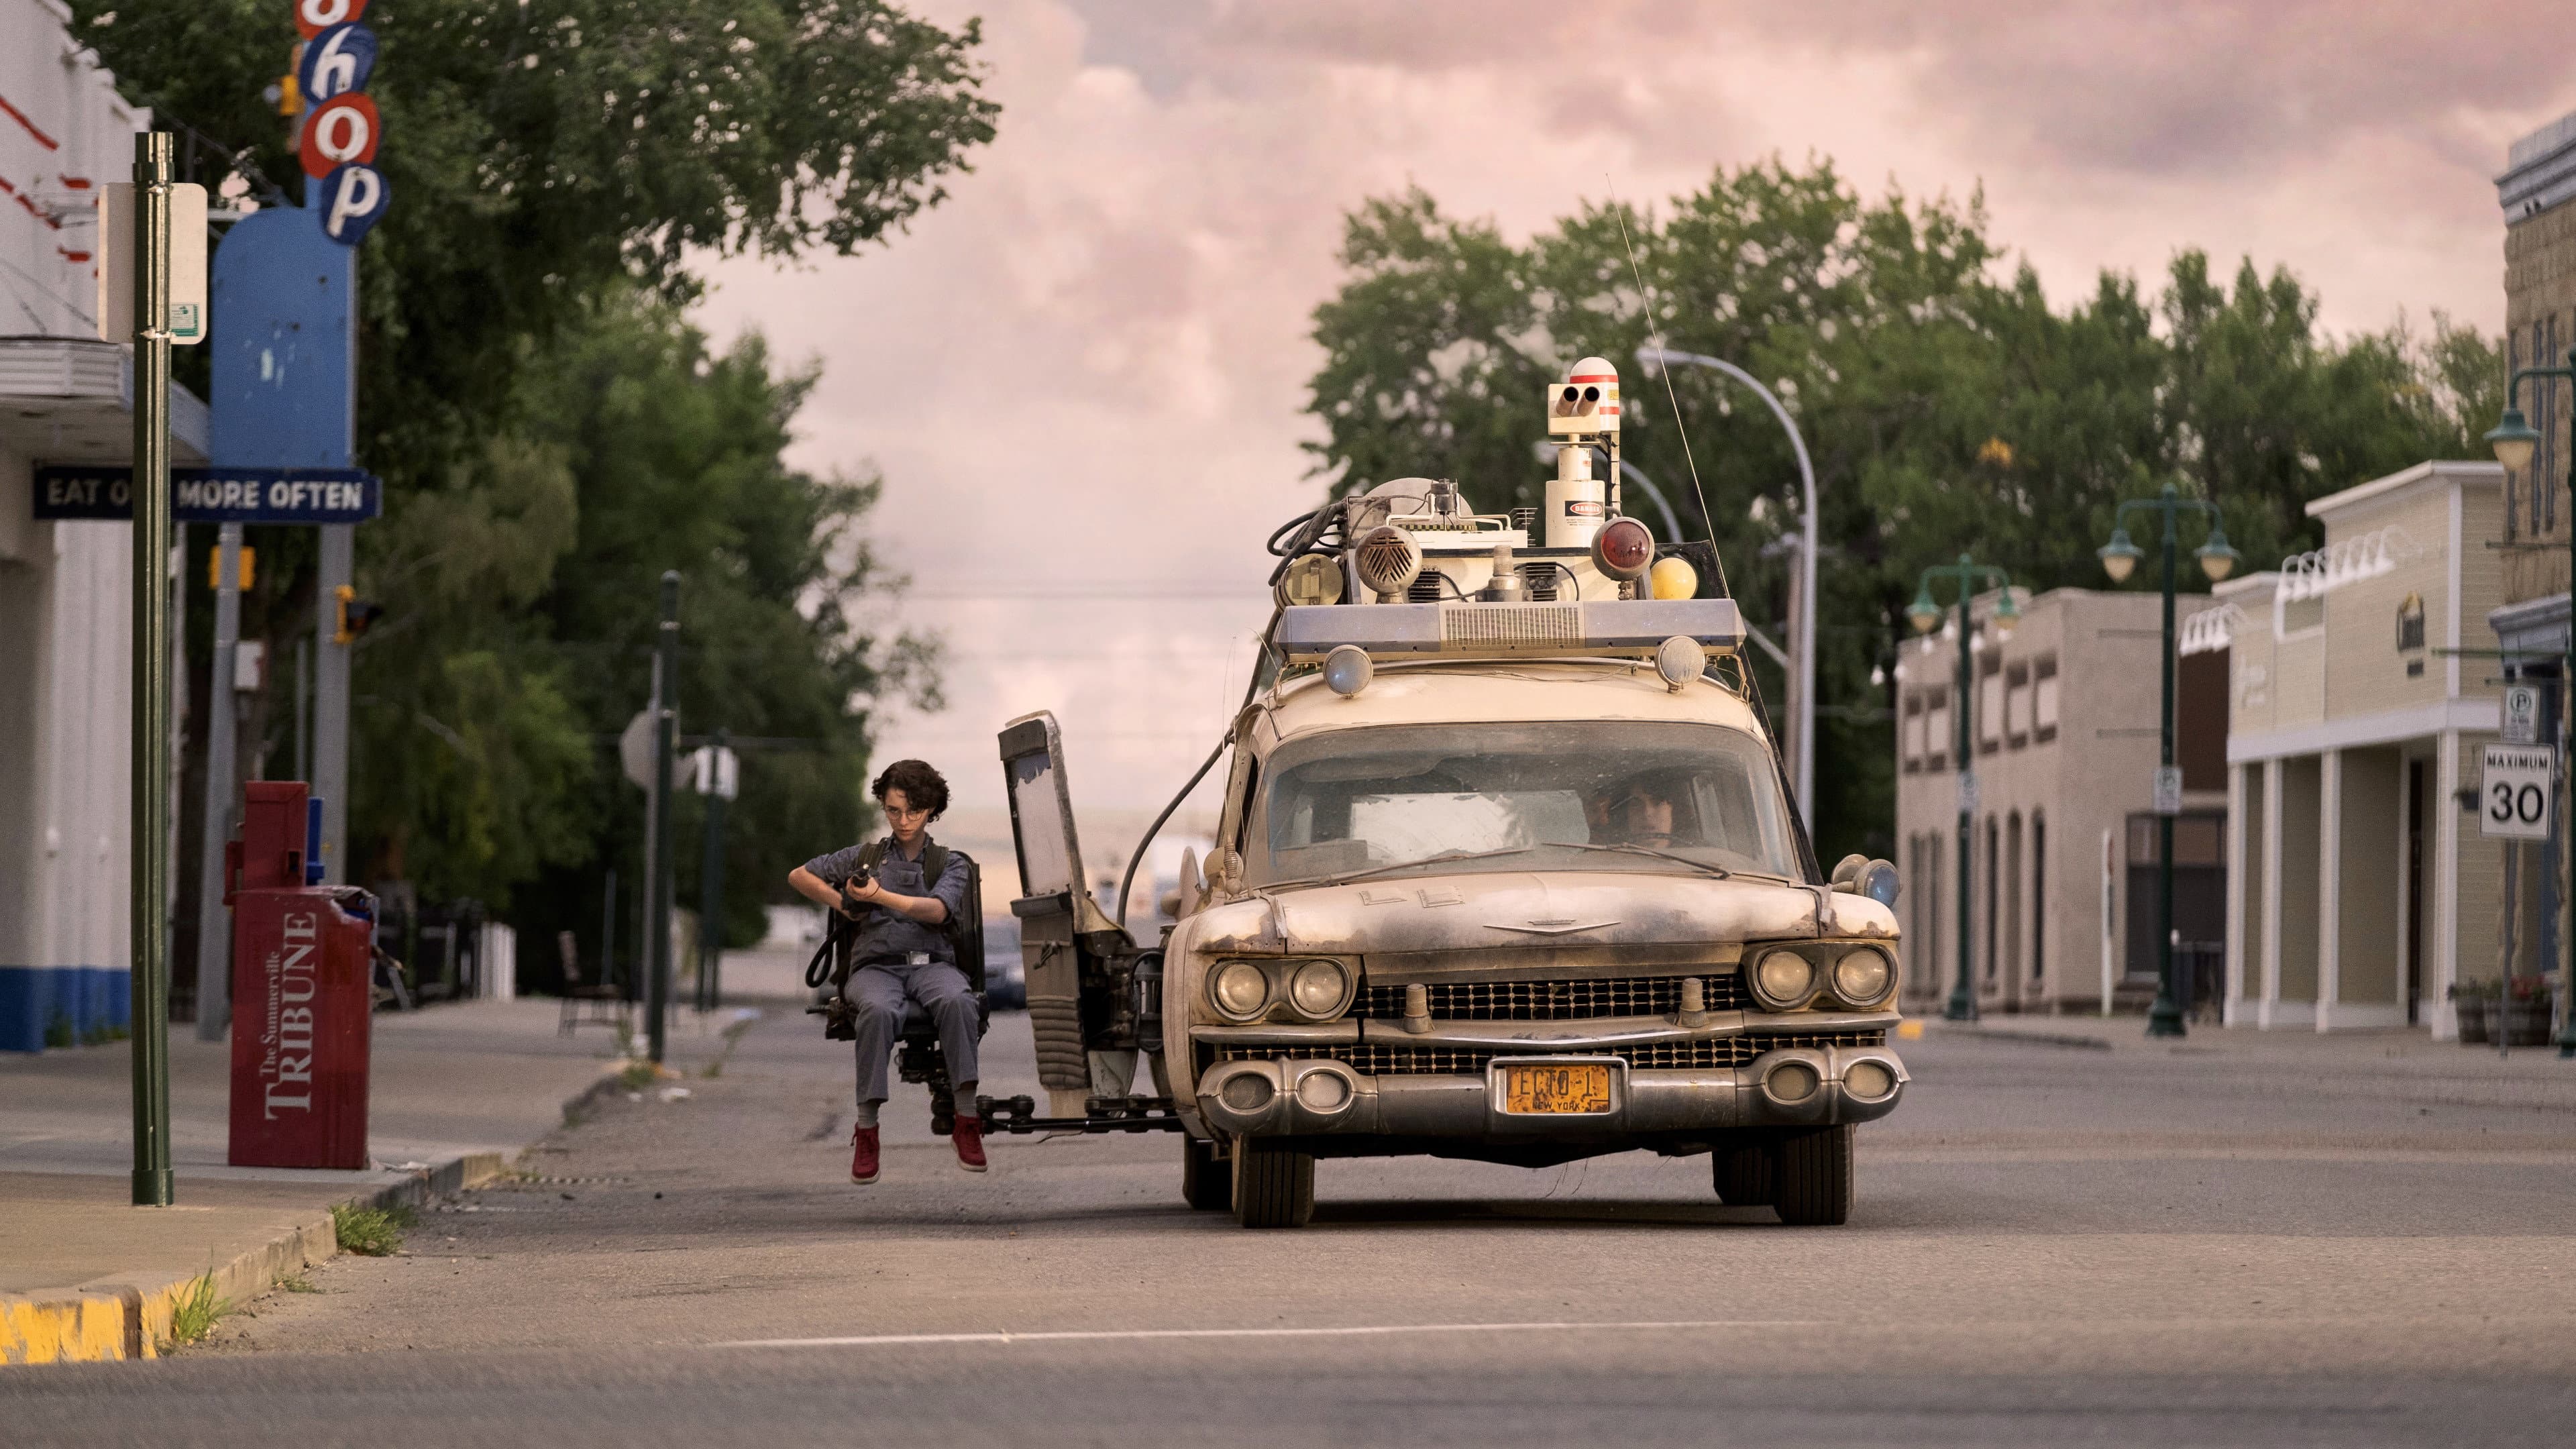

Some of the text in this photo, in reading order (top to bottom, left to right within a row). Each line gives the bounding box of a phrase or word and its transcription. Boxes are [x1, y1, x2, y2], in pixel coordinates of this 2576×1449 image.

[46, 478, 101, 506] EAT
[177, 480, 260, 510] MORE
[268, 481, 364, 511] OFTEN
[2486, 753, 2548, 769] MAXIMUM
[2491, 780, 2544, 824] 30
[258, 951, 280, 1077] The Summerville
[264, 912, 317, 1121] TRIBUNE
[1533, 1101, 1580, 1111] NEW YORK
